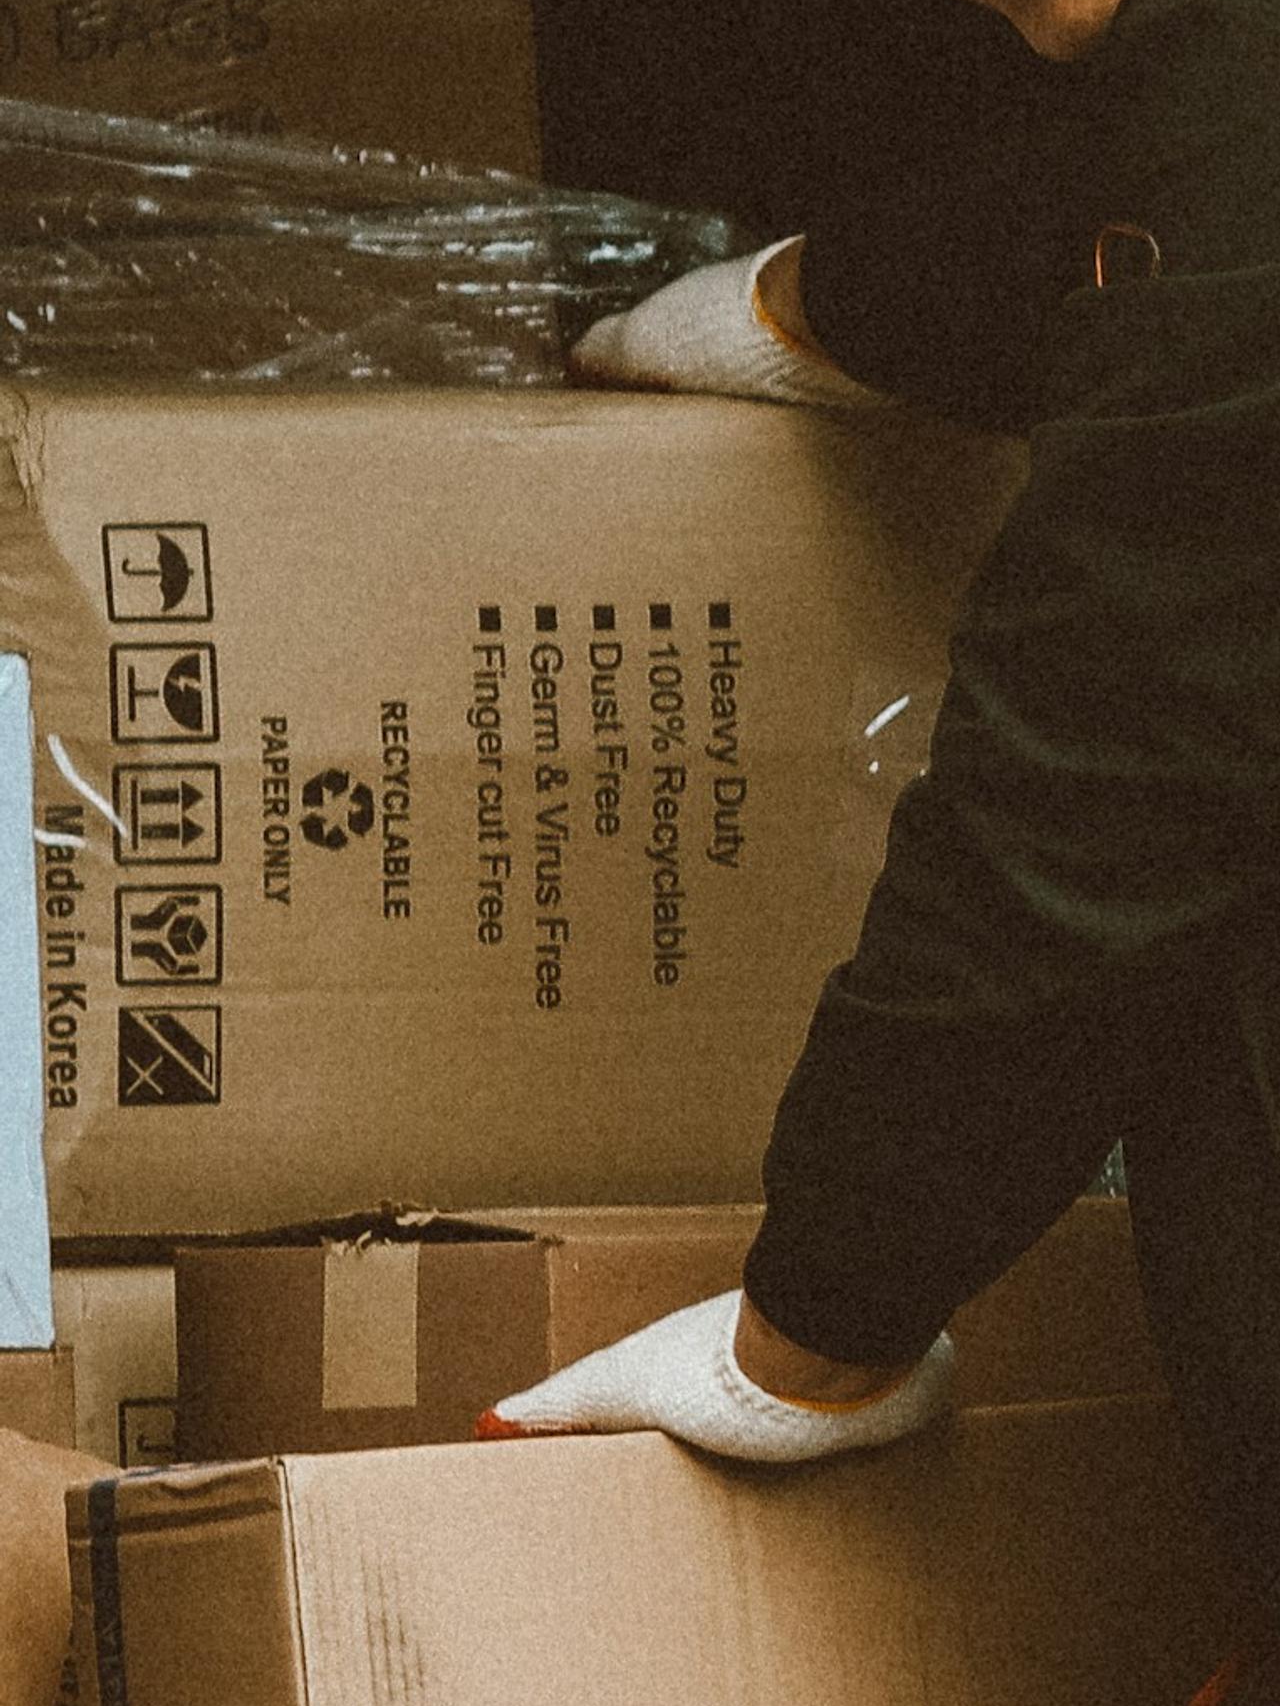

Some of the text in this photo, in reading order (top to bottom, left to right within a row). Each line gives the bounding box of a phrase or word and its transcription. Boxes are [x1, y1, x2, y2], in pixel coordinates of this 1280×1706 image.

[261, 717, 290, 905] PAPER ONLY
[381, 702, 410, 919] RECYCLABLE
[467, 646, 509, 945] Finger cut Free
[529, 645, 568, 1010] Germ & Virus Free
[589, 642, 628, 836] Dust Free
[648, 643, 687, 986] 100% Recyclable
[706, 640, 747, 868] Heavy Duty
[44, 805, 86, 1110] Made in Korea
